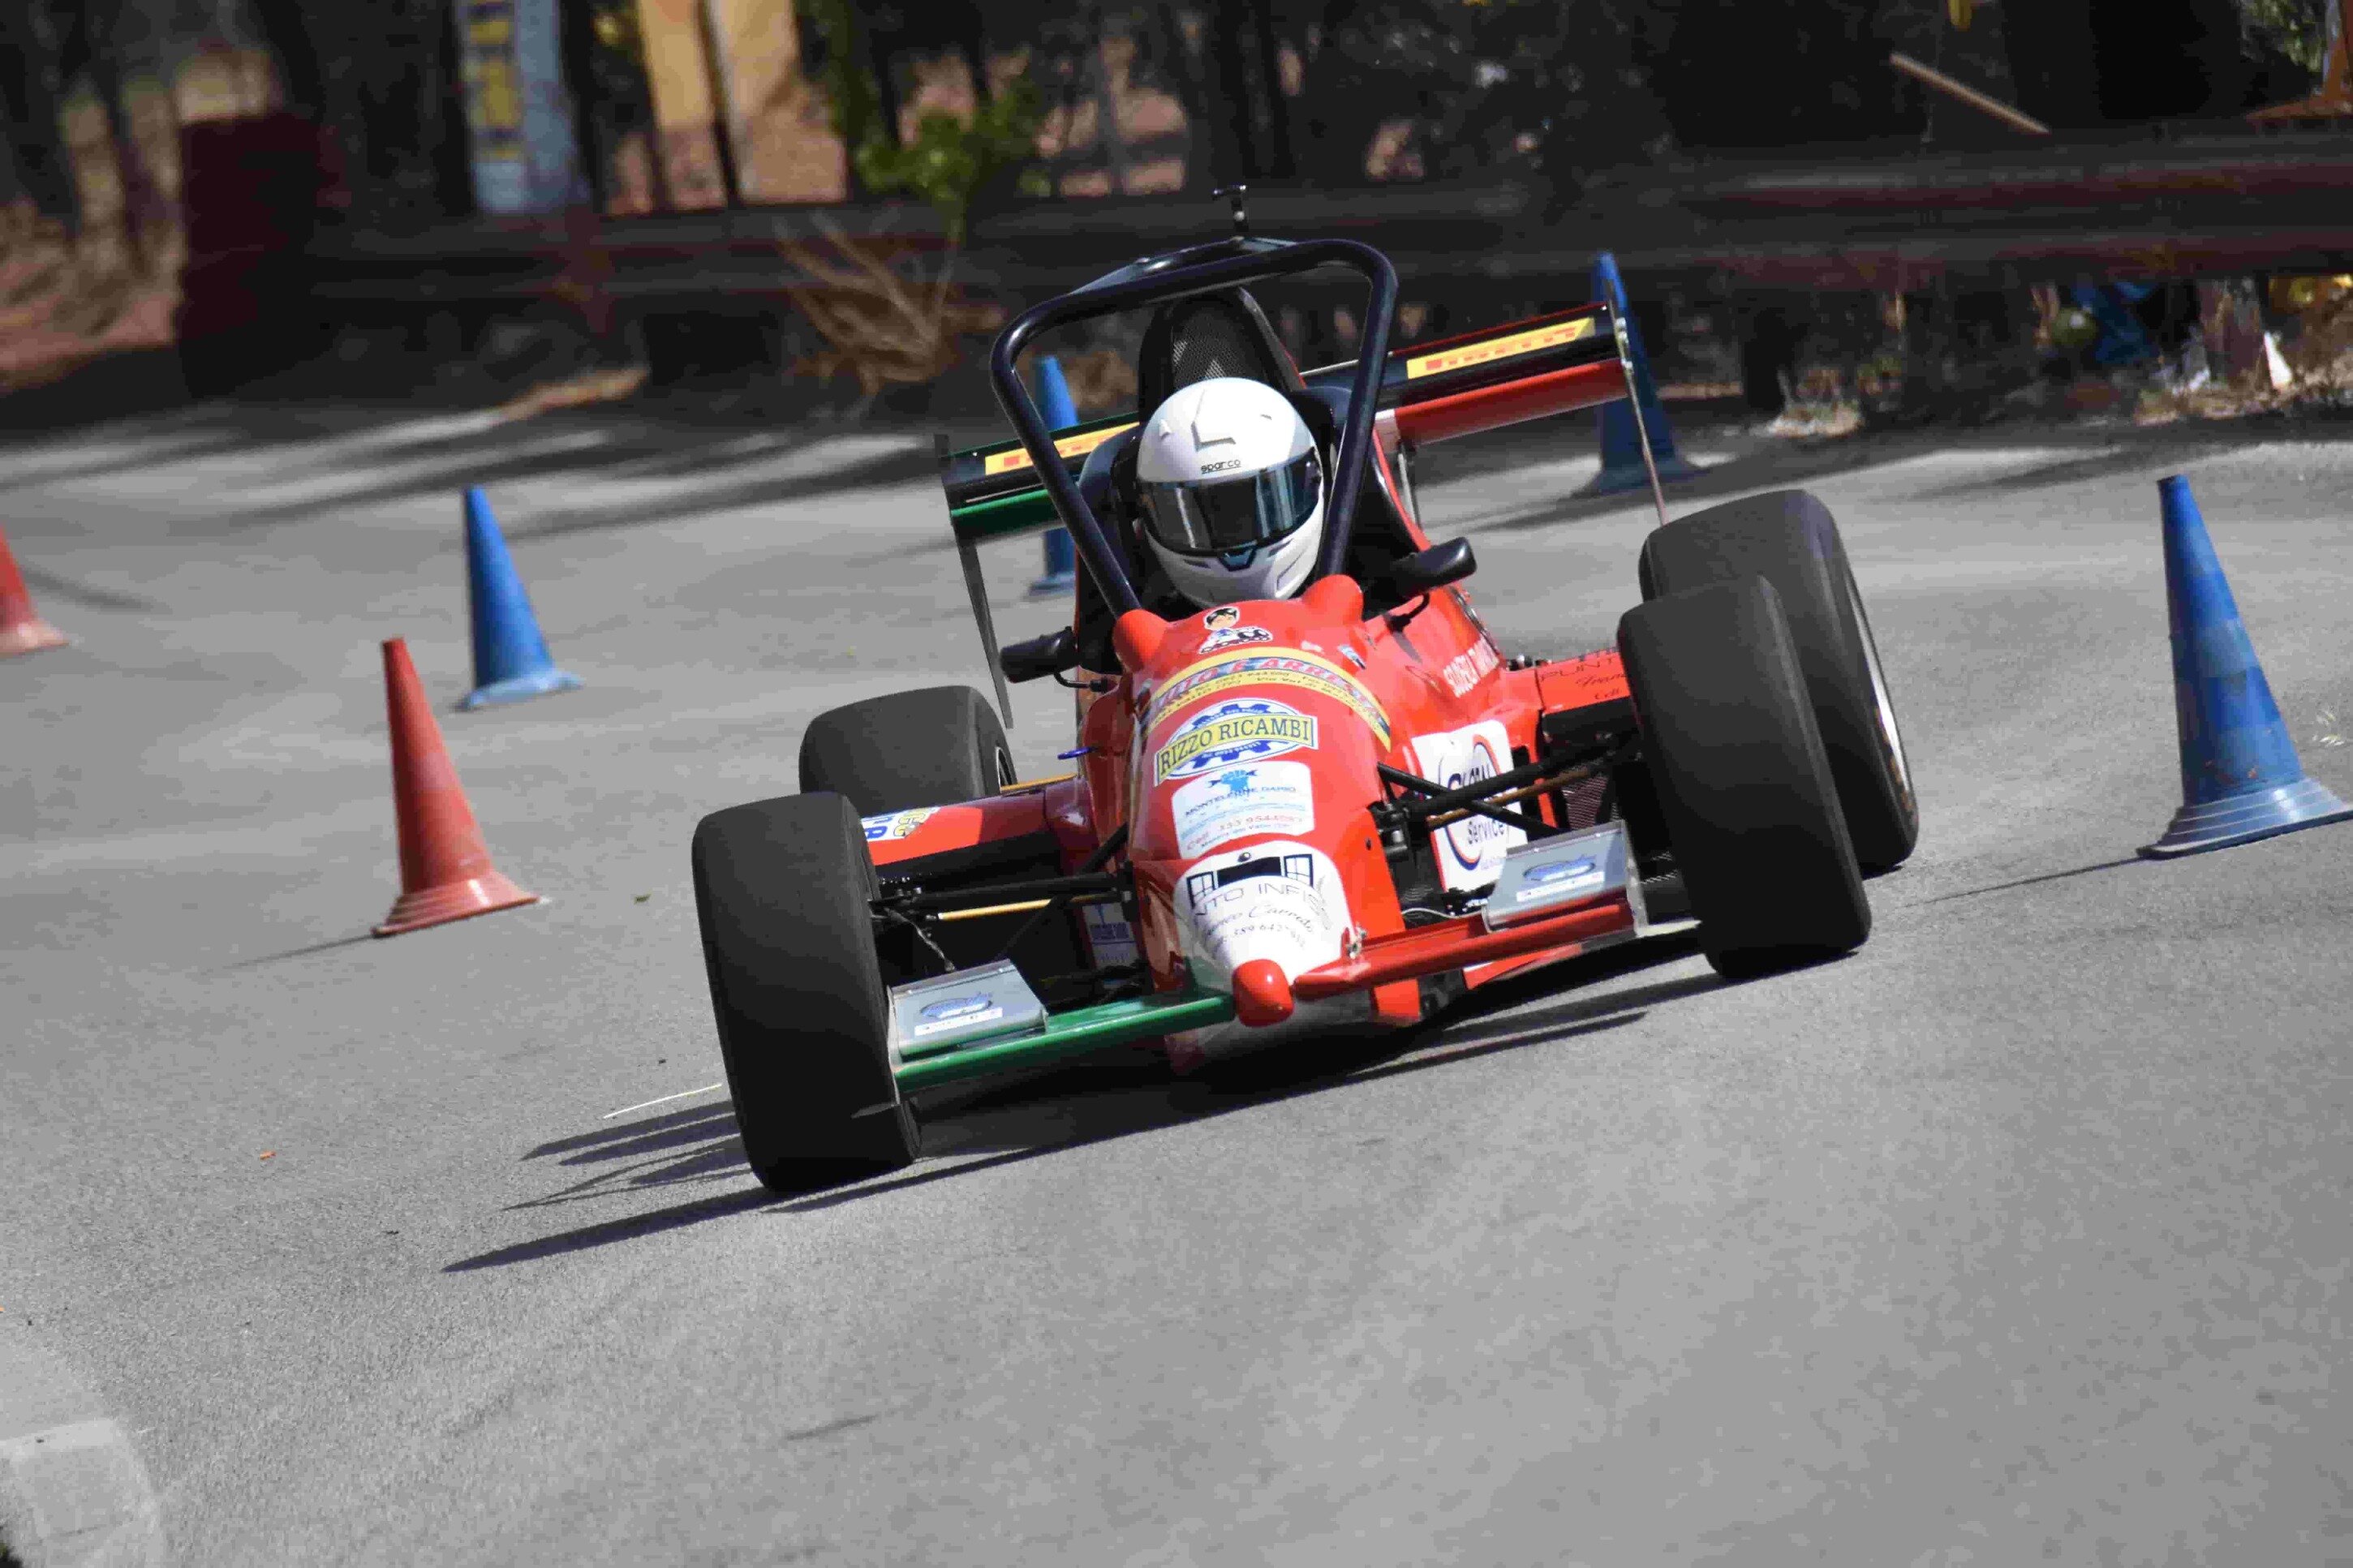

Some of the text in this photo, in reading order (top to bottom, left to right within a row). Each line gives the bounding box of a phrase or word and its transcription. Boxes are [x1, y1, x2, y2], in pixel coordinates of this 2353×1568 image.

[1201, 459, 1241, 474] sparco
[1160, 729, 1213, 775] RIZZO
[1219, 717, 1310, 742] RICAMBI
